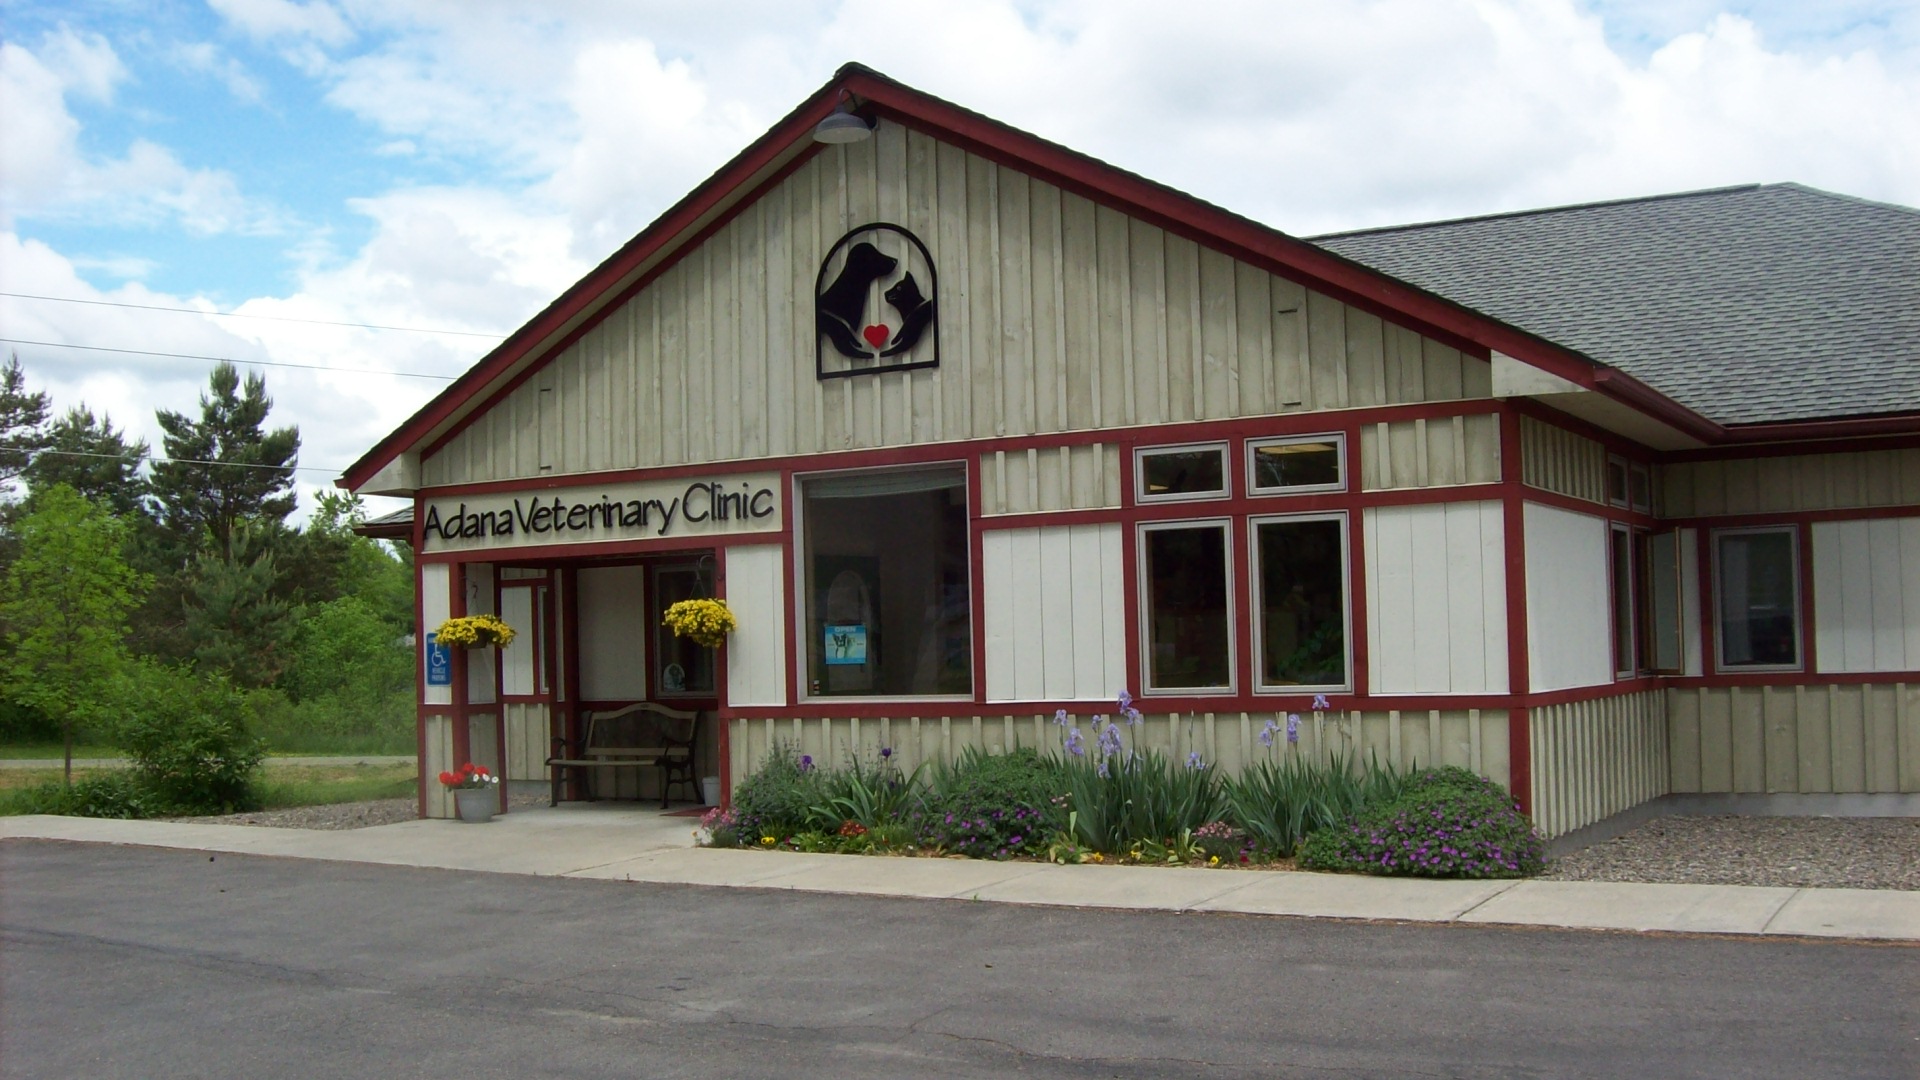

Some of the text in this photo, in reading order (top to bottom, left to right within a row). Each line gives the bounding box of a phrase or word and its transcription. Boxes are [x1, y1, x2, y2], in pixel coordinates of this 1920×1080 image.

[424, 482, 774, 540] Adana Veterinary Clinic
